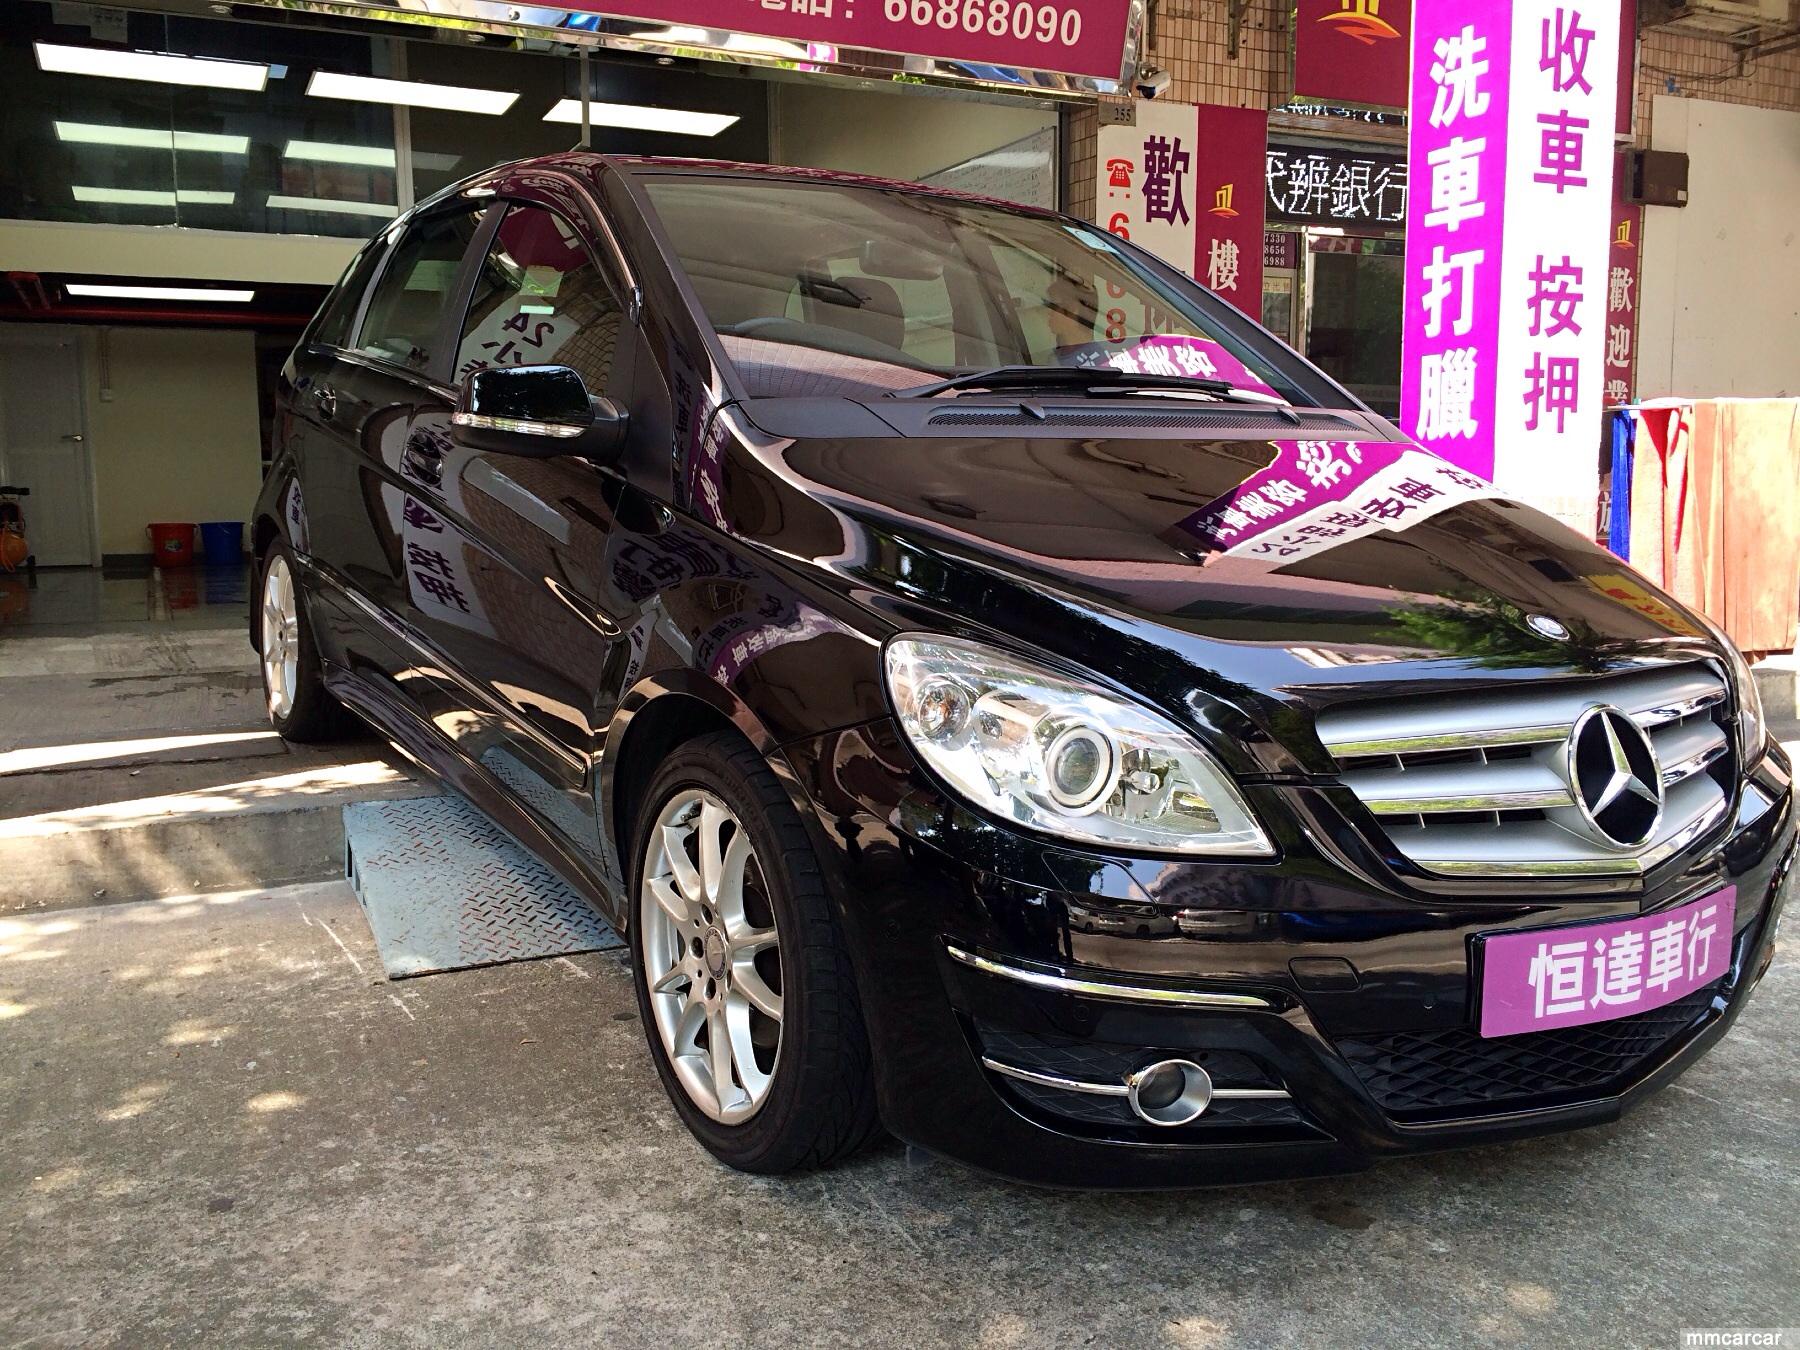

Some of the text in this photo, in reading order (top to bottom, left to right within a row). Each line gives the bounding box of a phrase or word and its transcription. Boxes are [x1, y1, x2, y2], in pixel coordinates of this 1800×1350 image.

[883, 0, 1082, 46] 66868090
[1207, 239, 1239, 291] 樓
[1416, 25, 1491, 441] 洗車打臘
[1524, 7, 1596, 434] 收車 按押
[1528, 905, 1717, 1018] 恒達車行
